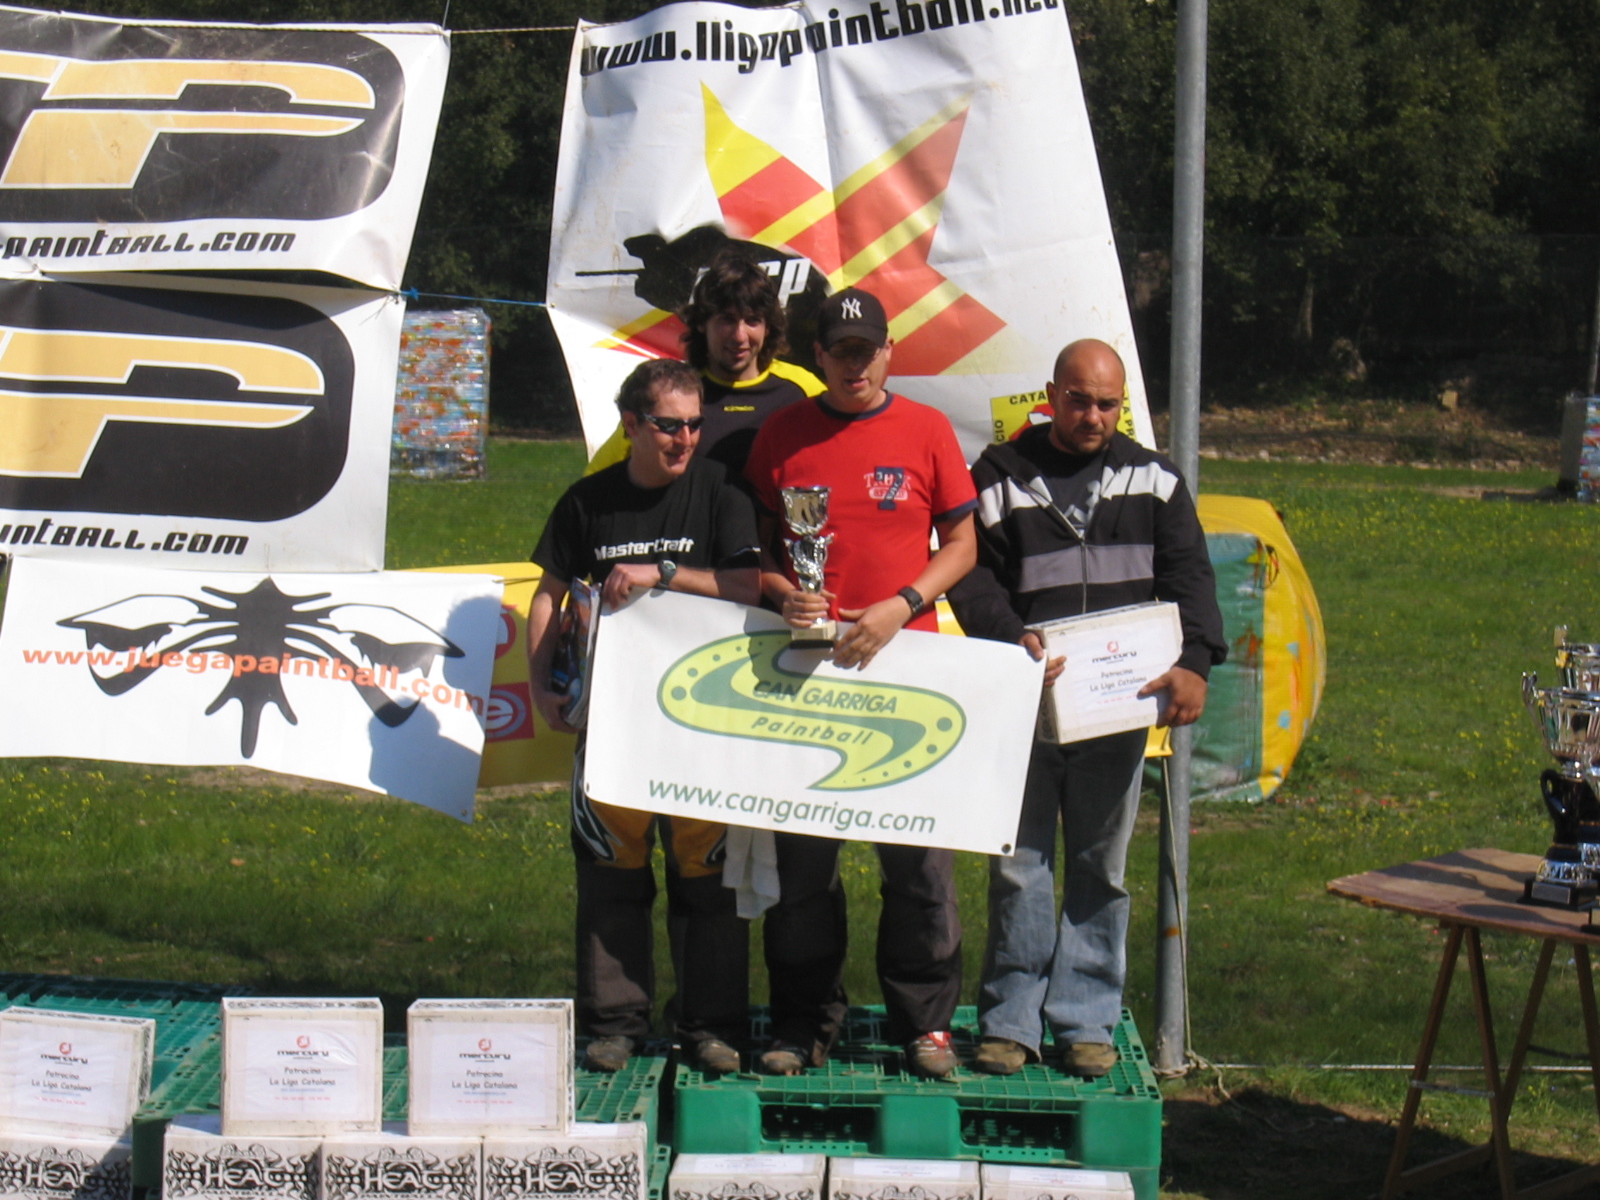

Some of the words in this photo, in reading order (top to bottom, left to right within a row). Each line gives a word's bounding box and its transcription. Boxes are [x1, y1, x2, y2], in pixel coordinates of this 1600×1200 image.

[594, 537, 694, 560] MasterCraft
[22, 645, 486, 717] www.juegapaintball.com
[753, 681, 800, 702] CAN
[802, 687, 898, 714] GARRIGA
[751, 716, 873, 745] Paintball
[649, 779, 936, 833] www.cangarriga.com
